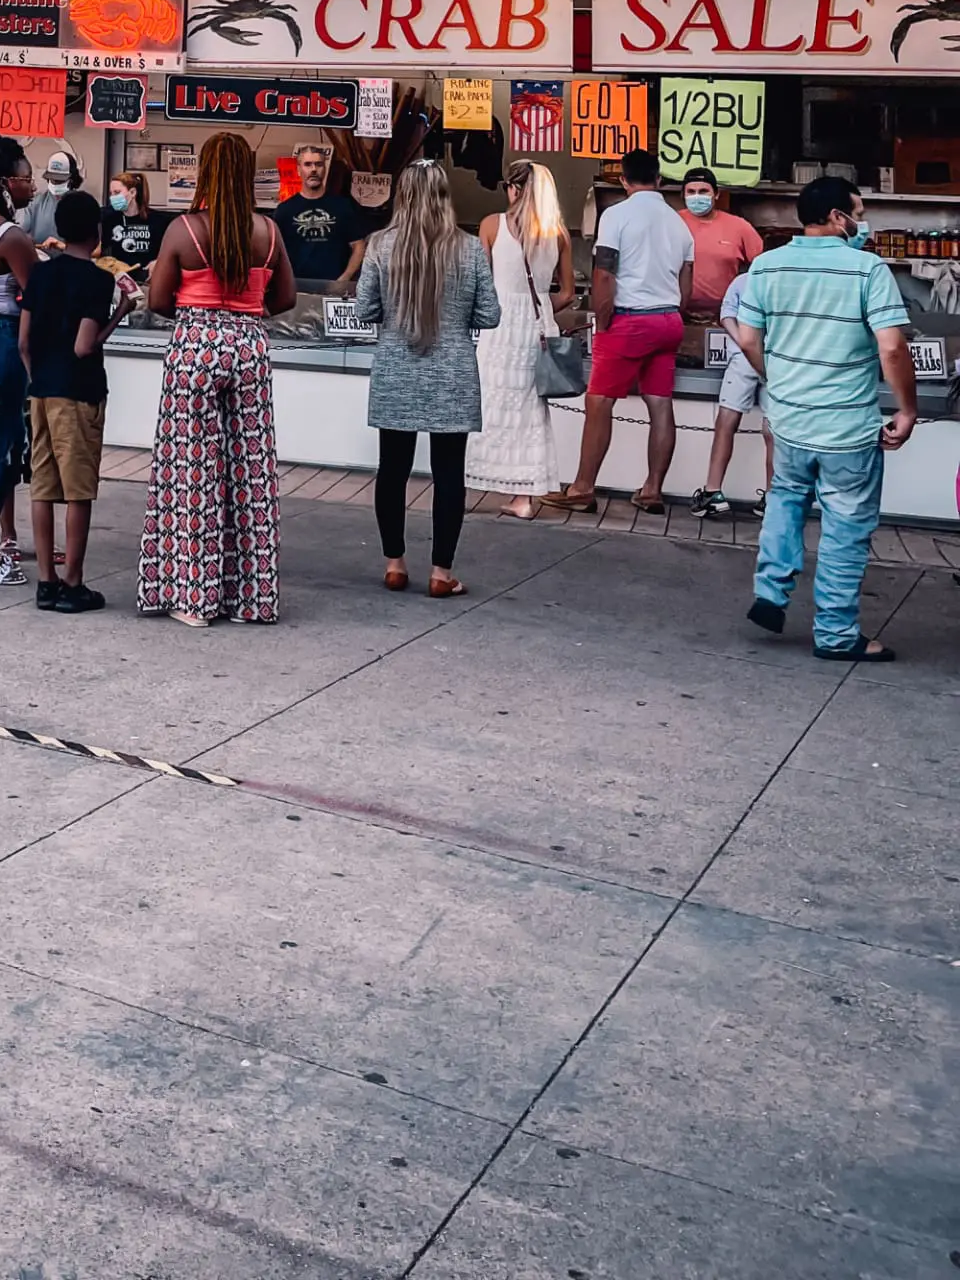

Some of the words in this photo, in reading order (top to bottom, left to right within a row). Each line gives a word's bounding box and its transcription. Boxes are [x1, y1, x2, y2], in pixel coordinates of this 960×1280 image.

[73, 55, 90, 67] 3/4
[104, 57, 132, 69] OVER
[174, 85, 242, 113] Live
[254, 88, 349, 119] Crabs
[372, 94, 391, 107] Sauce
[577, 82, 645, 122] GOT
[663, 90, 762, 131] 1/2BU
[660, 129, 761, 171] SALE
[169, 156, 197, 166] JUMBO
[122, 238, 150, 252] CITY
[333, 305, 357, 317] MEDIU
[328, 317, 348, 329] MALE
[709, 349, 727, 362] FEMA
[914, 358, 941, 371] CRABS
